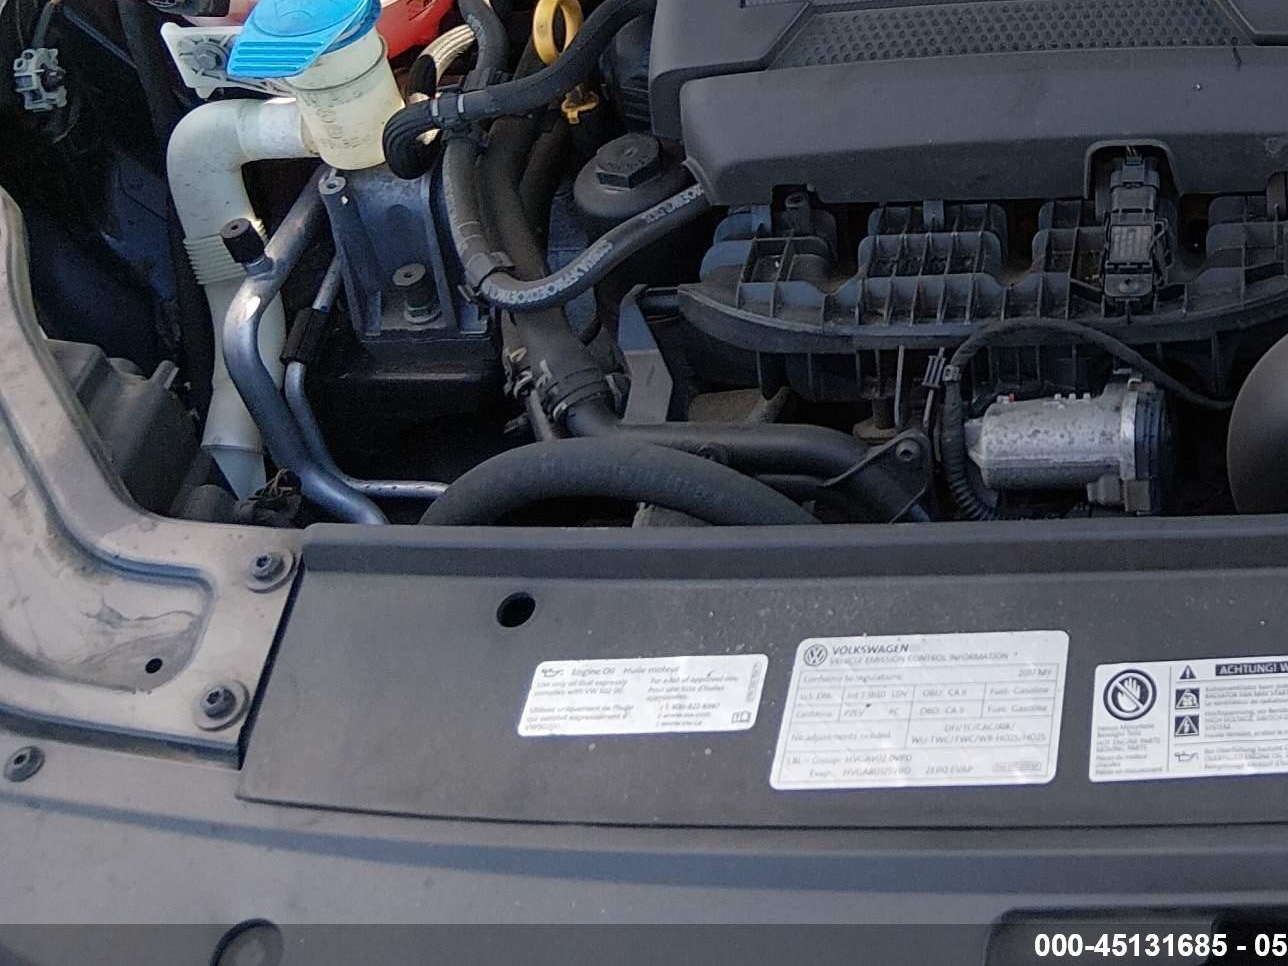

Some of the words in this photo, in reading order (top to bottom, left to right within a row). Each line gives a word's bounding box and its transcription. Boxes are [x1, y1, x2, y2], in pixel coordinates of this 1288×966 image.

[832, 643, 909, 654] VOLKSWAGEN
[948, 651, 1009, 661] INFORMATION
[1219, 663, 1276, 674] ACHTUNG!
